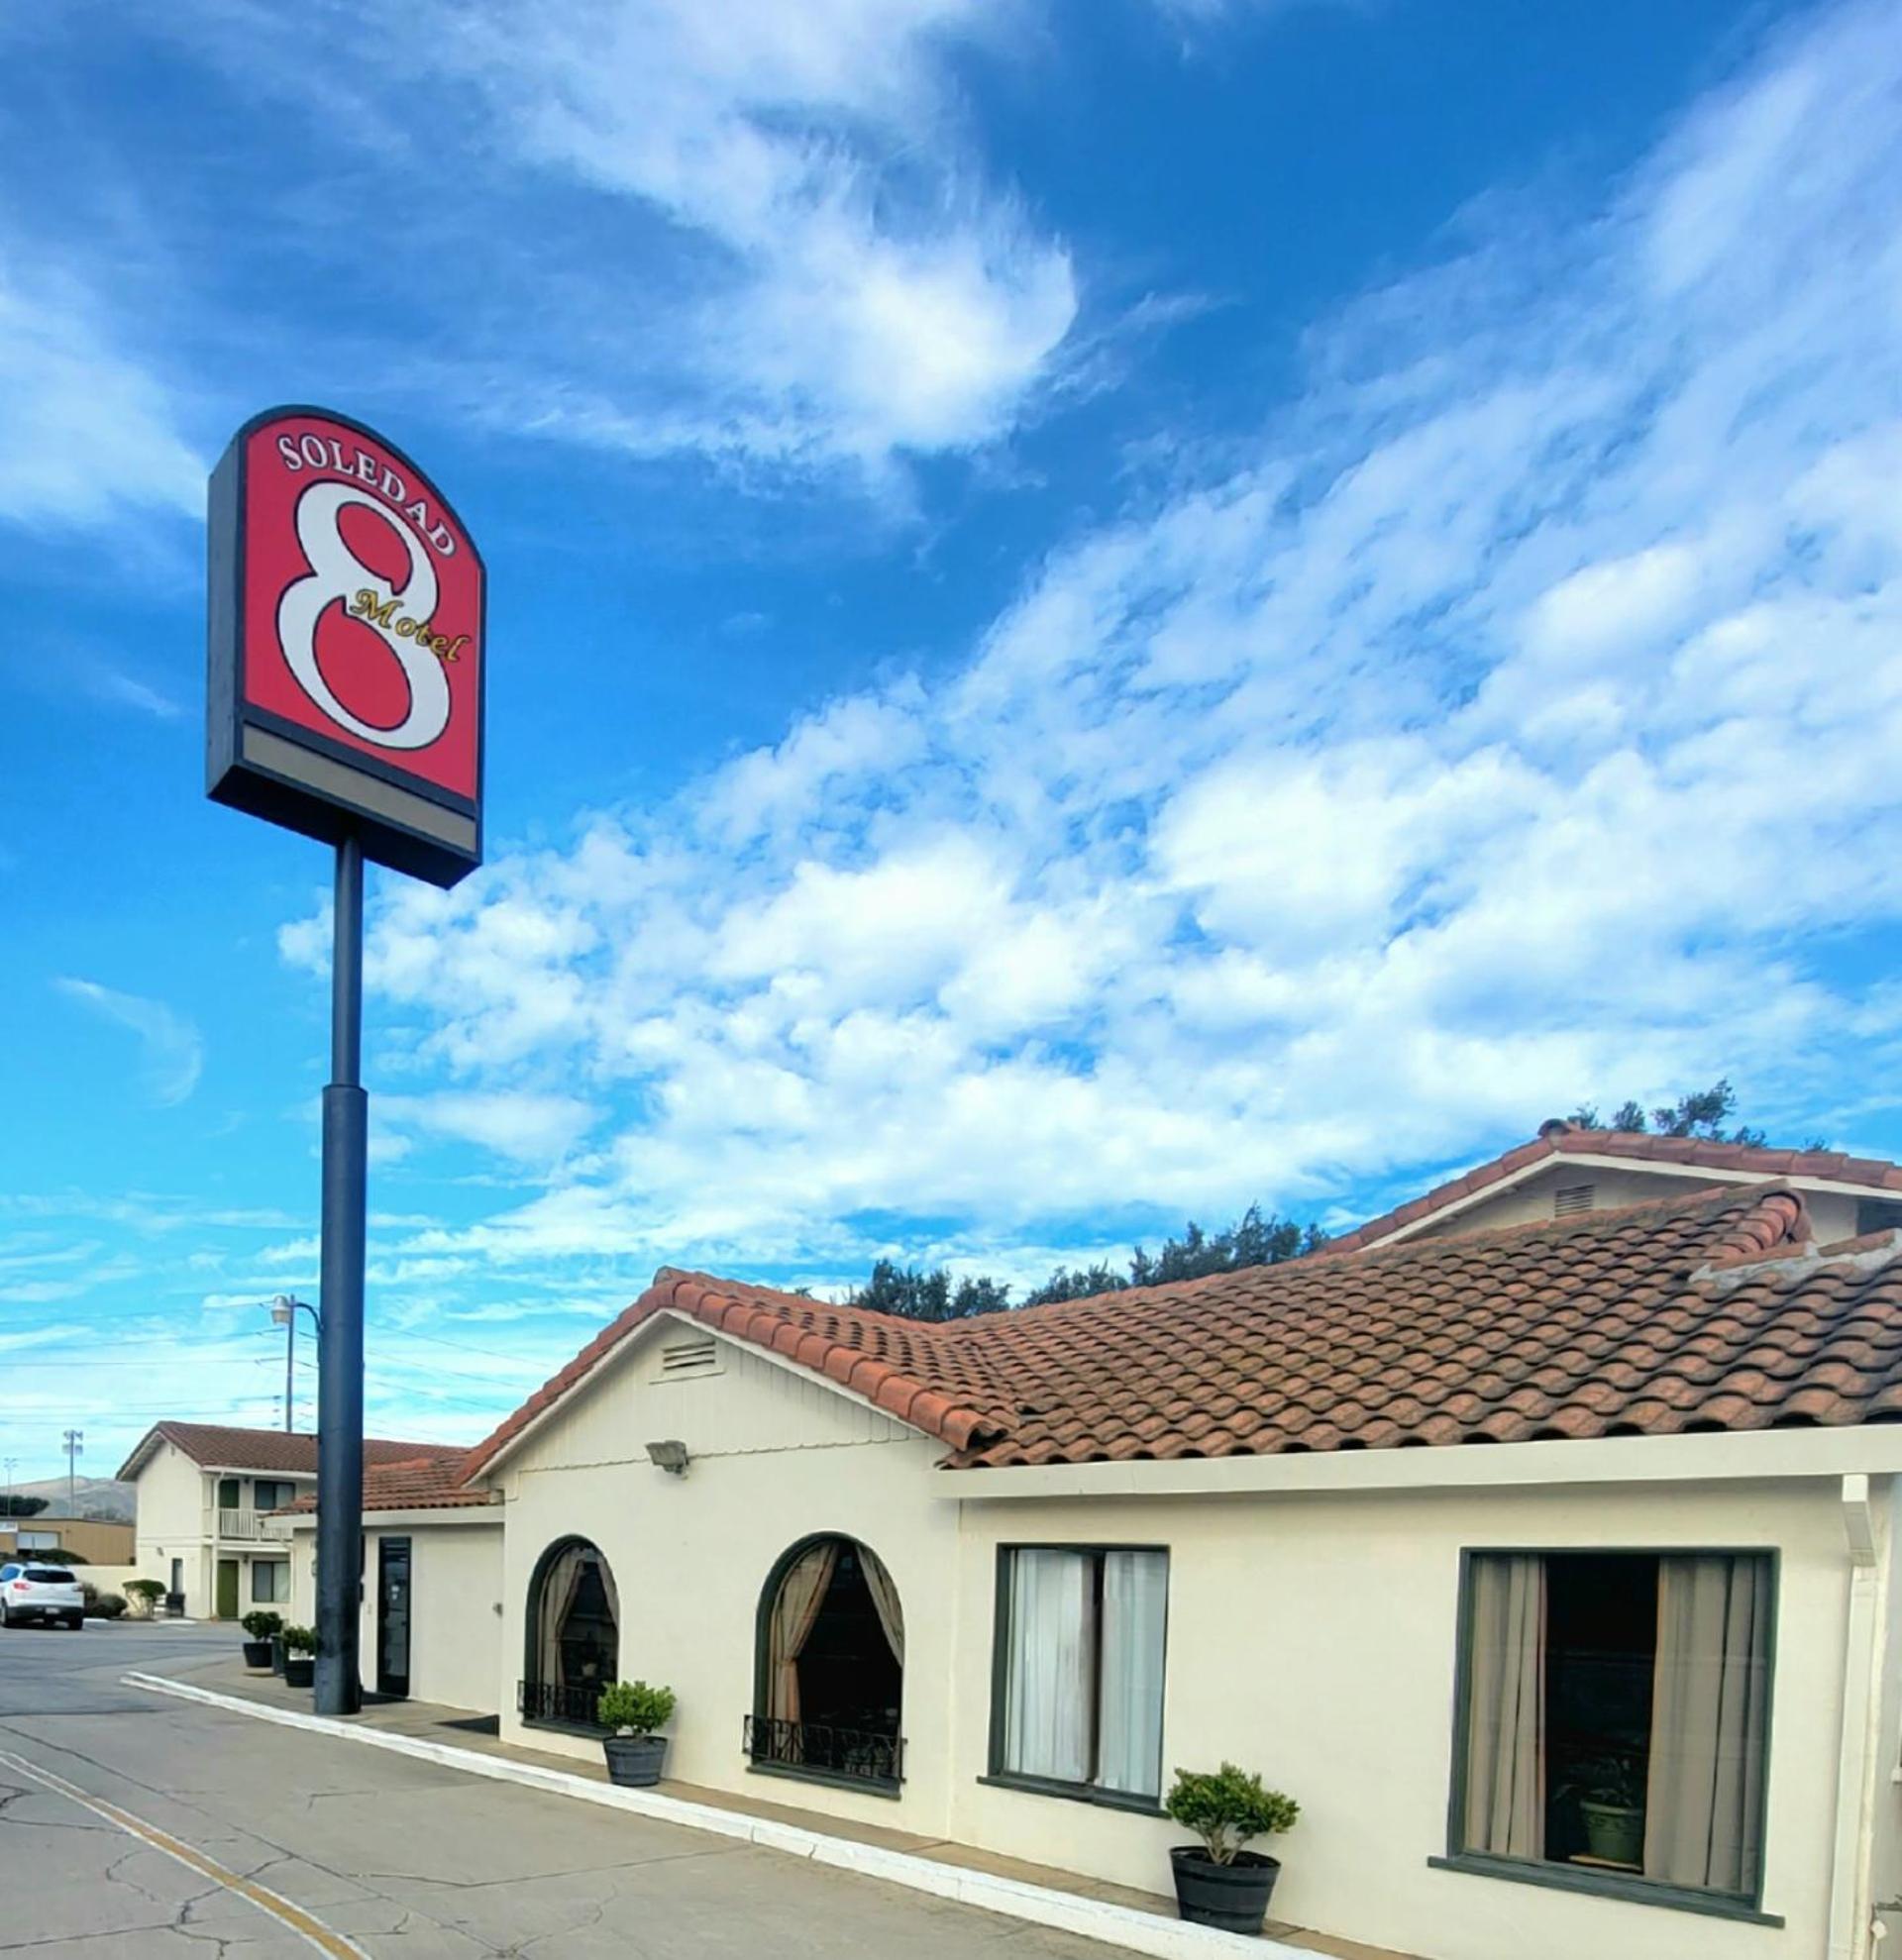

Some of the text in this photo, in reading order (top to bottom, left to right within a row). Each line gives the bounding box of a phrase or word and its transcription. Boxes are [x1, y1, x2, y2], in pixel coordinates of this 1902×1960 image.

[277, 434, 456, 557] SOLEDAD
[276, 479, 451, 750] 8
[350, 589, 472, 663] Motel
